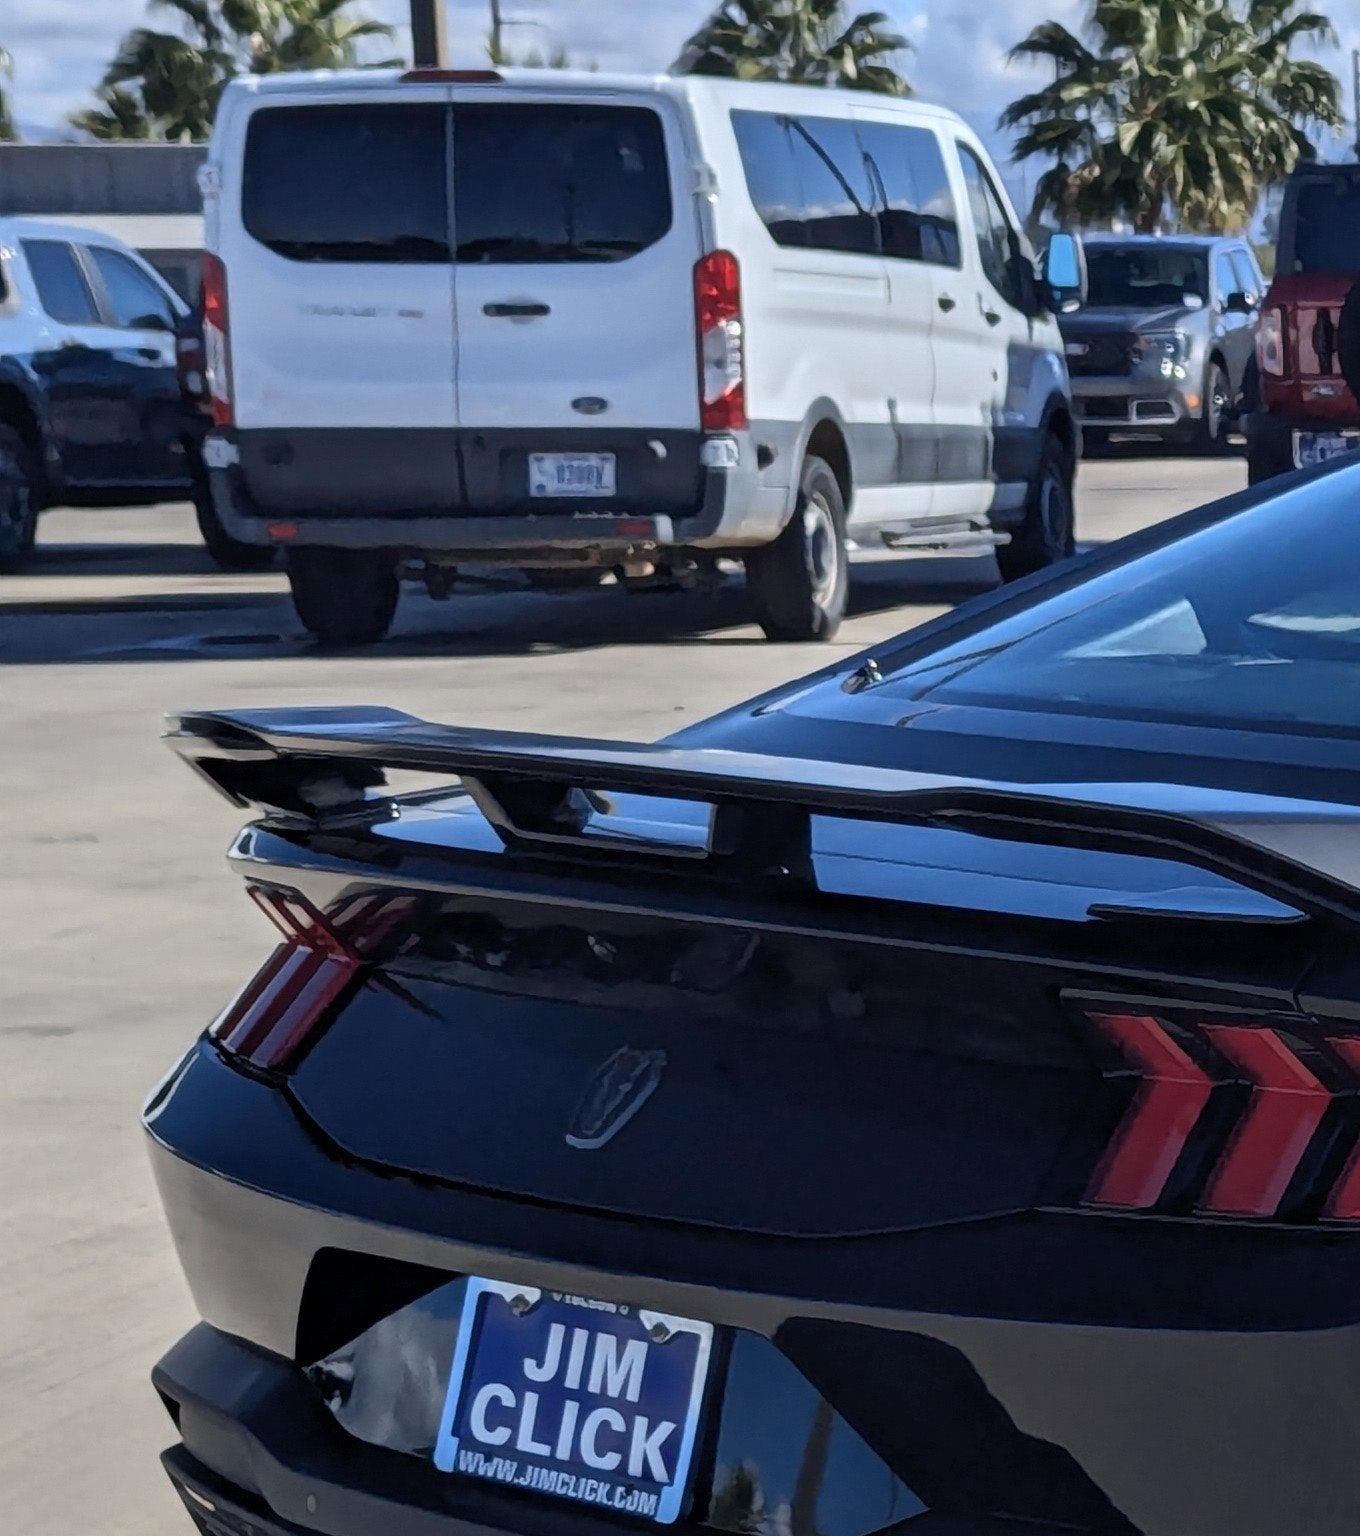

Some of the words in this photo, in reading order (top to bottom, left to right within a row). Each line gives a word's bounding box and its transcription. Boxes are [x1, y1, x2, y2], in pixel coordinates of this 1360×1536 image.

[523, 1323, 649, 1403] JIM
[470, 1382, 678, 1483] CLICK
[458, 1449, 659, 1517] WWW.JIMCLICK.COM
